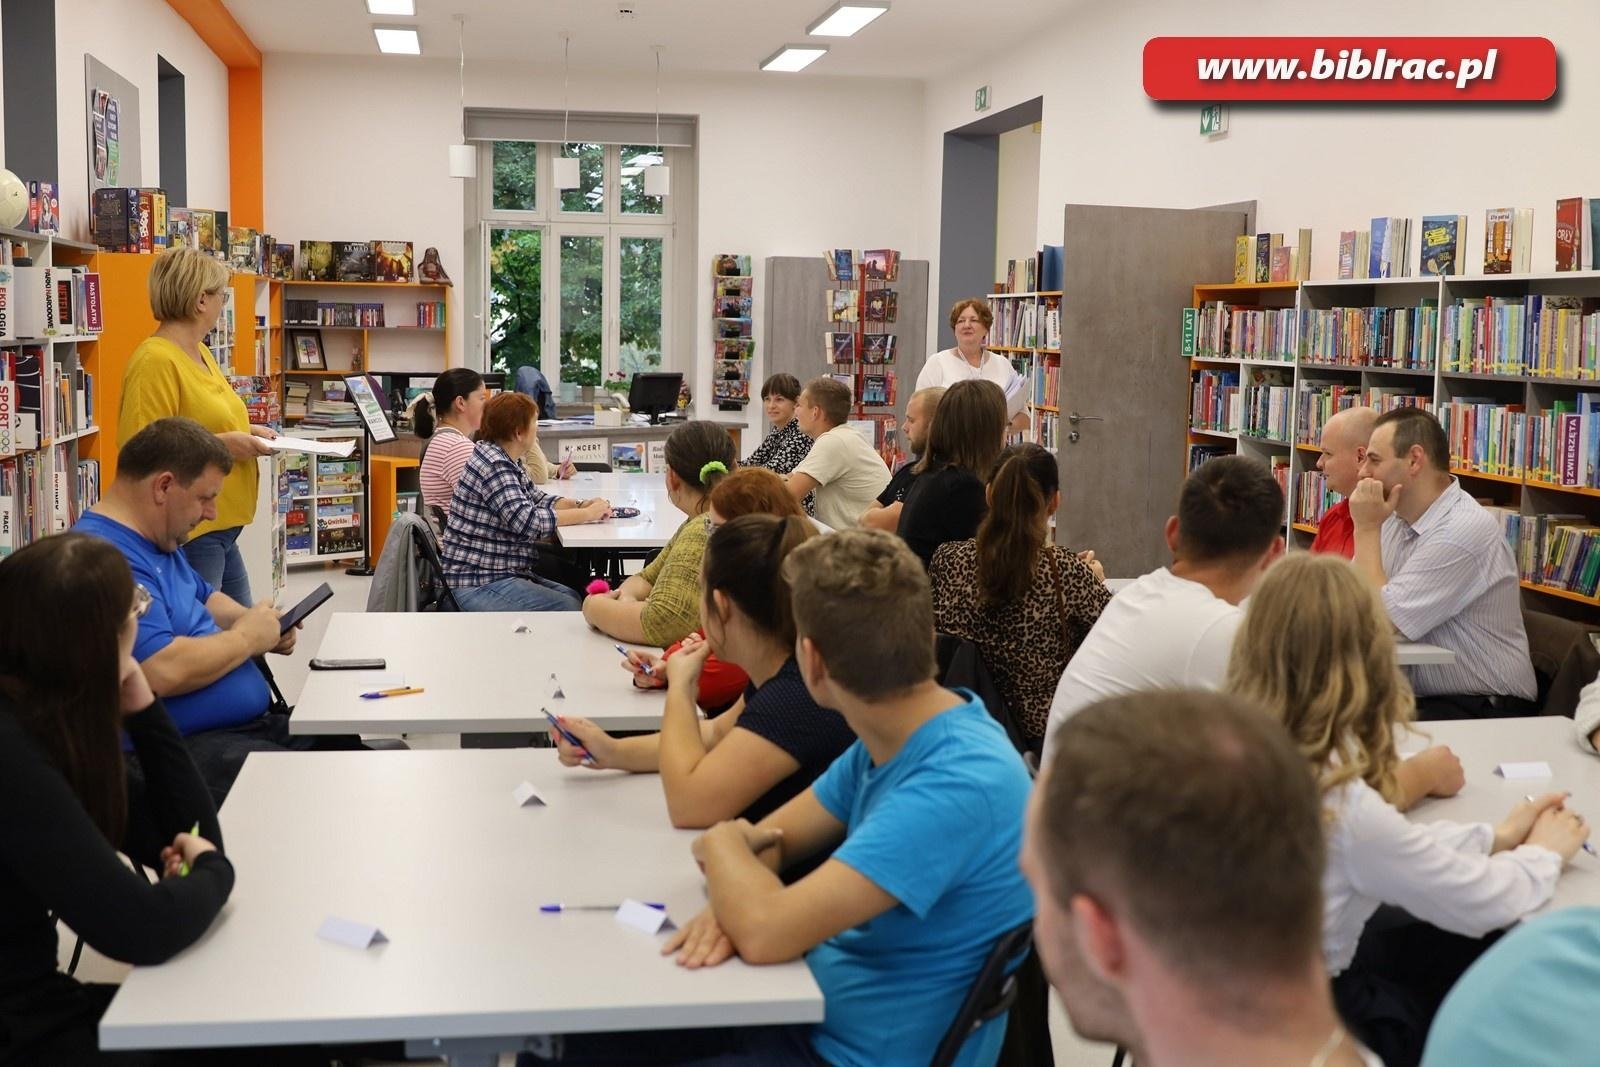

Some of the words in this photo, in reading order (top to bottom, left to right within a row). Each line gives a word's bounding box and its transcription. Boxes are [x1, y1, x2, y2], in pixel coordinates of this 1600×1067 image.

[45, 289, 54, 329] NARODOWE
[89, 282, 97, 324] NASTOLATKI
[1185, 312, 1193, 331] LAT
[1184, 333, 1192, 352] 8-11
[0, 385, 9, 429] SPORT
[1566, 418, 1577, 477] ZWIERZĘTA
